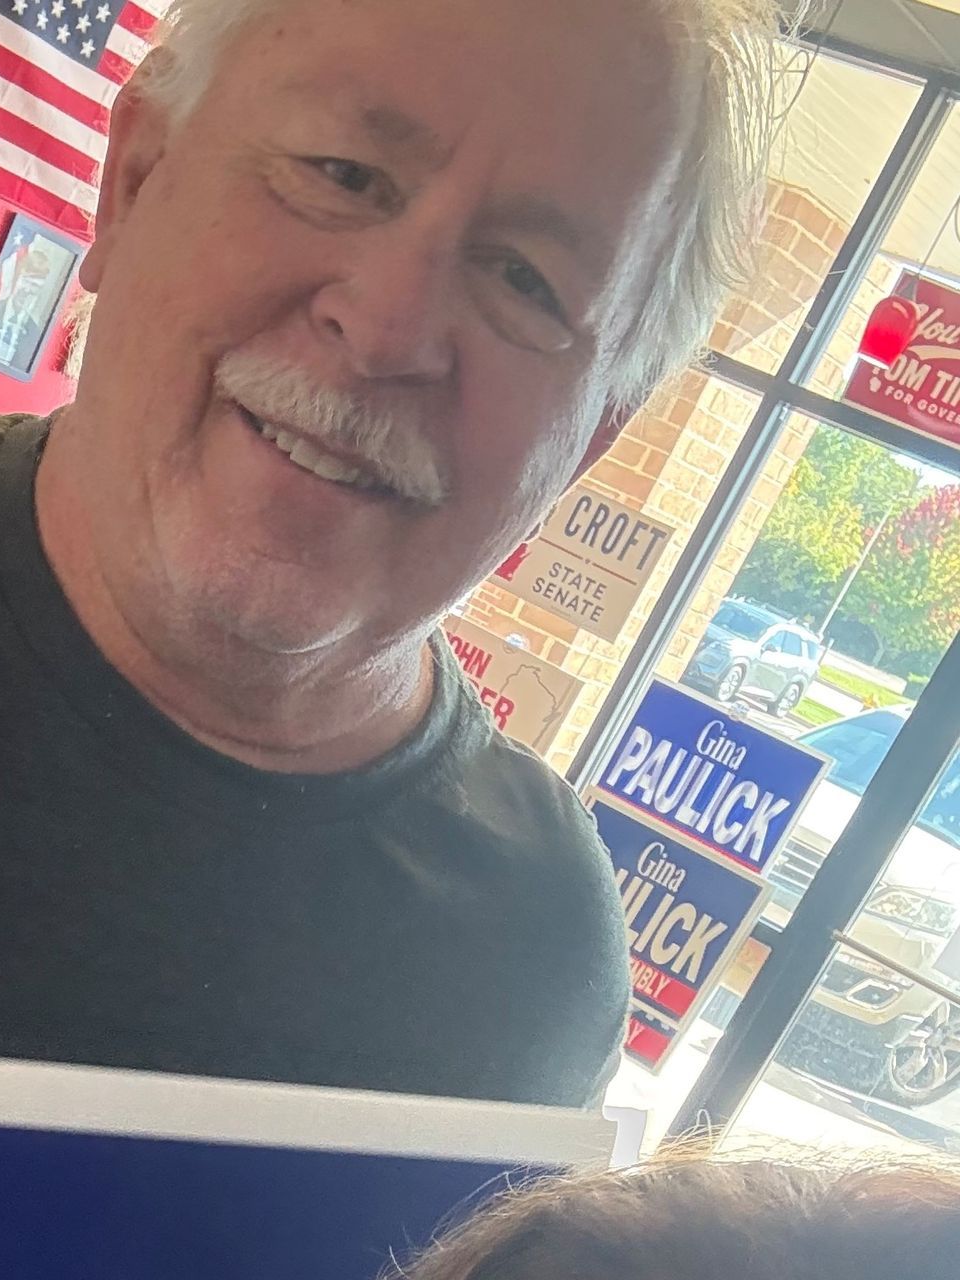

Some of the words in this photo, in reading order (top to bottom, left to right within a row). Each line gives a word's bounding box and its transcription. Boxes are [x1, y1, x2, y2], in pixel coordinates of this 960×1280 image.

[872, 353, 932, 392] OM
[884, 385, 914, 405] FOR
[532, 577, 605, 623] SENATE
[548, 562, 607, 601] STATE
[446, 631, 493, 679] OHN
[696, 719, 748, 771] Gina
[606, 726, 791, 862] PAULICK
[637, 841, 687, 893] Gina
